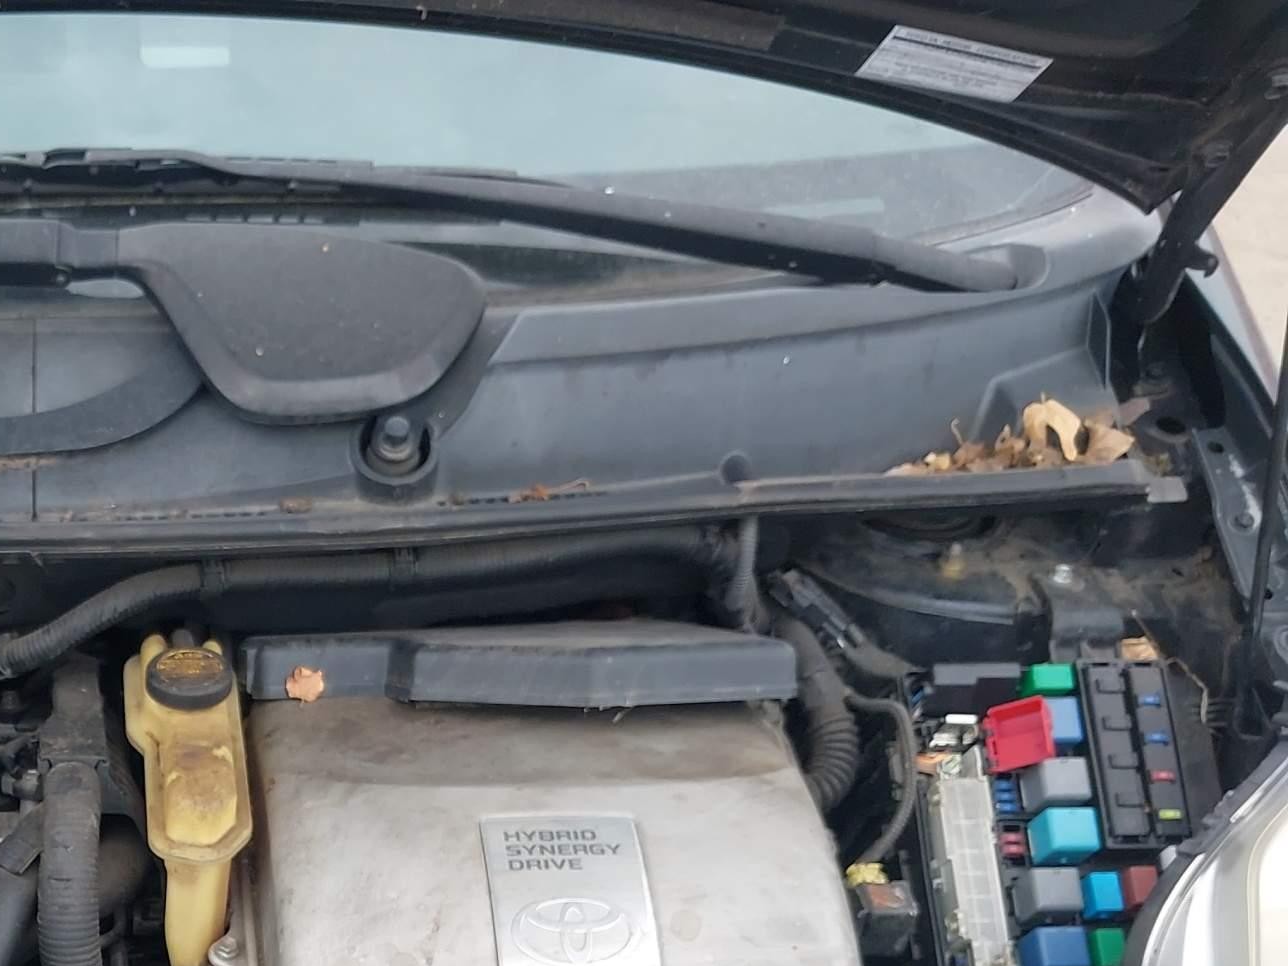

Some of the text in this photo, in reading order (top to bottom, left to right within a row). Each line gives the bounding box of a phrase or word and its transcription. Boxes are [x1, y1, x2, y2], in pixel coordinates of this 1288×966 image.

[503, 829, 597, 842] HYBRID
[505, 844, 621, 857] SYNERGY
[508, 858, 584, 871] DRIVE
